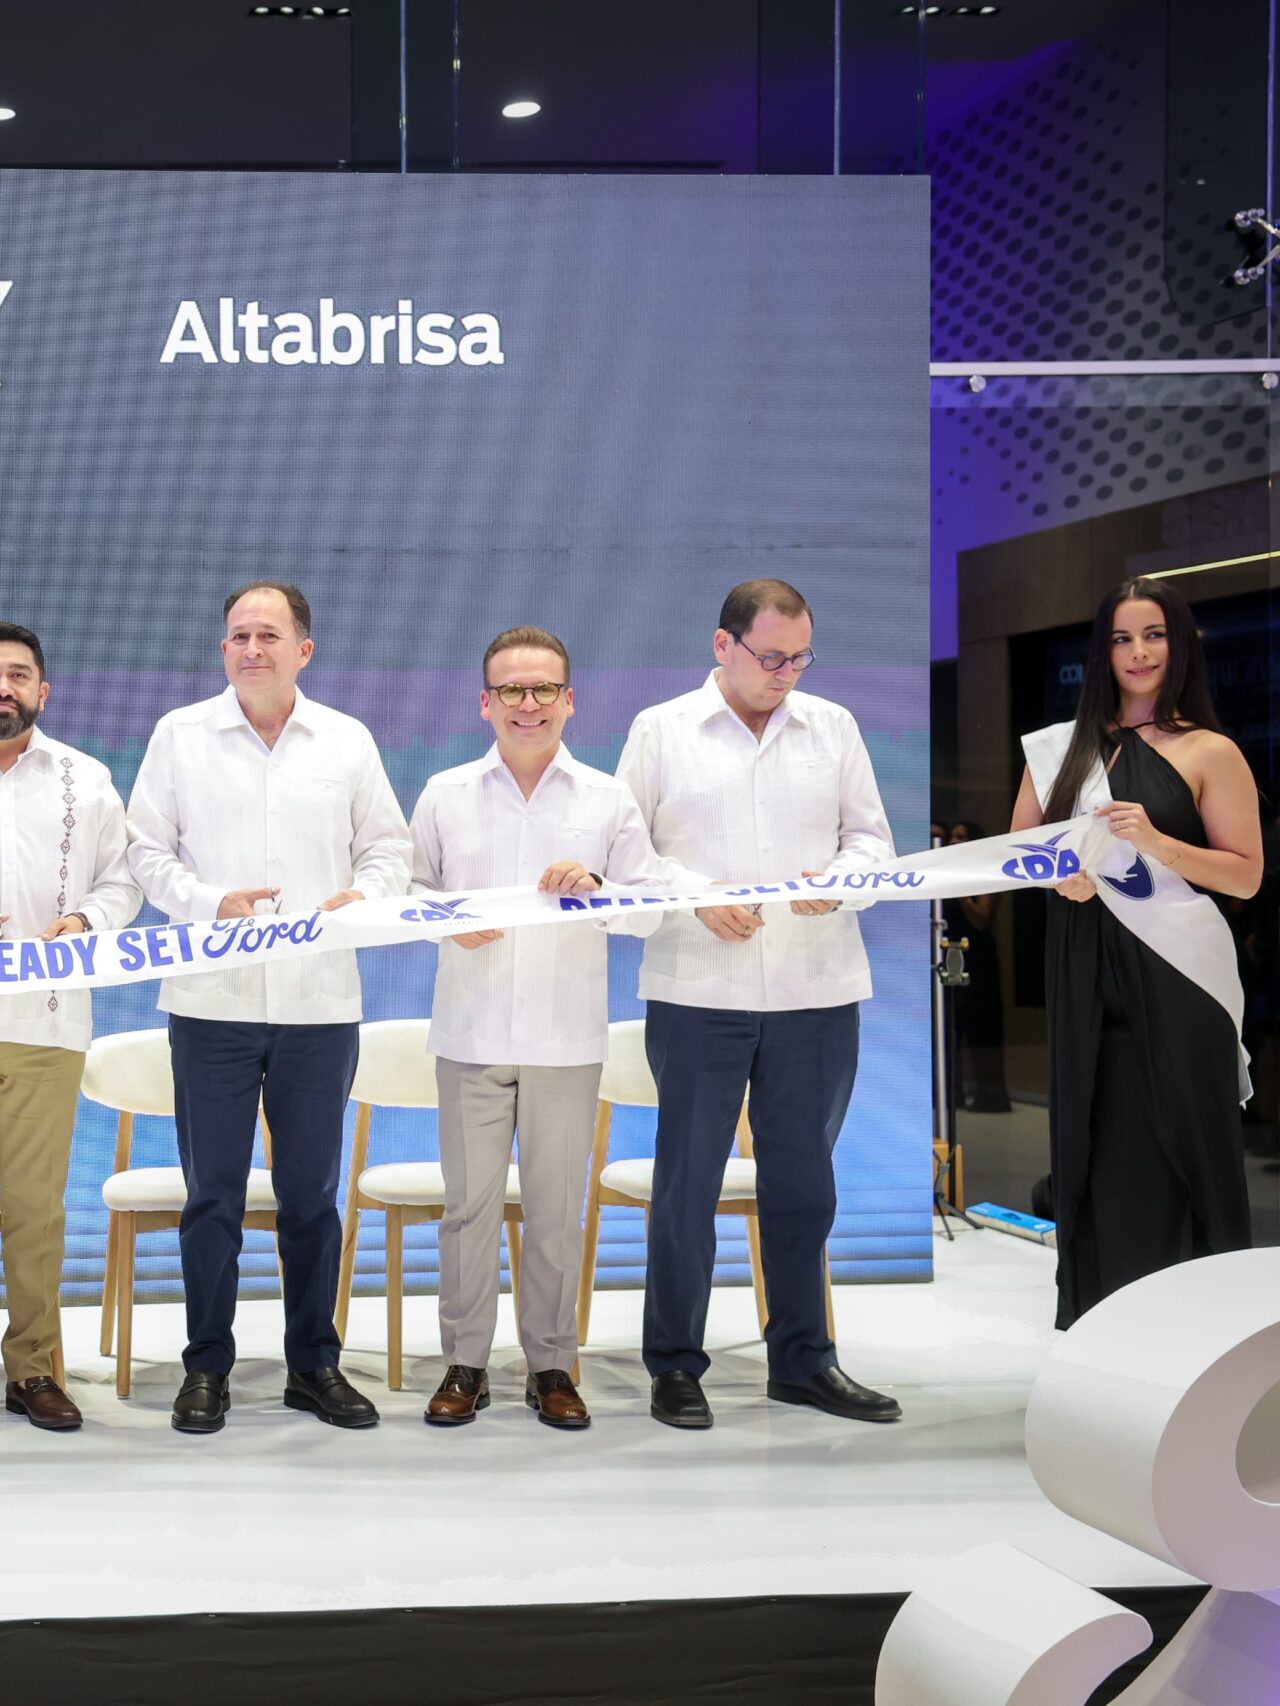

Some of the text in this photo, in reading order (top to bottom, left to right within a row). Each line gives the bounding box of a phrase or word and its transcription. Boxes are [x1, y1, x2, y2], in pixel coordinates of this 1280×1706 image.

[160, 297, 506, 366] Altabrisa
[119, 922, 195, 972] SET
[202, 911, 324, 959] Ford
